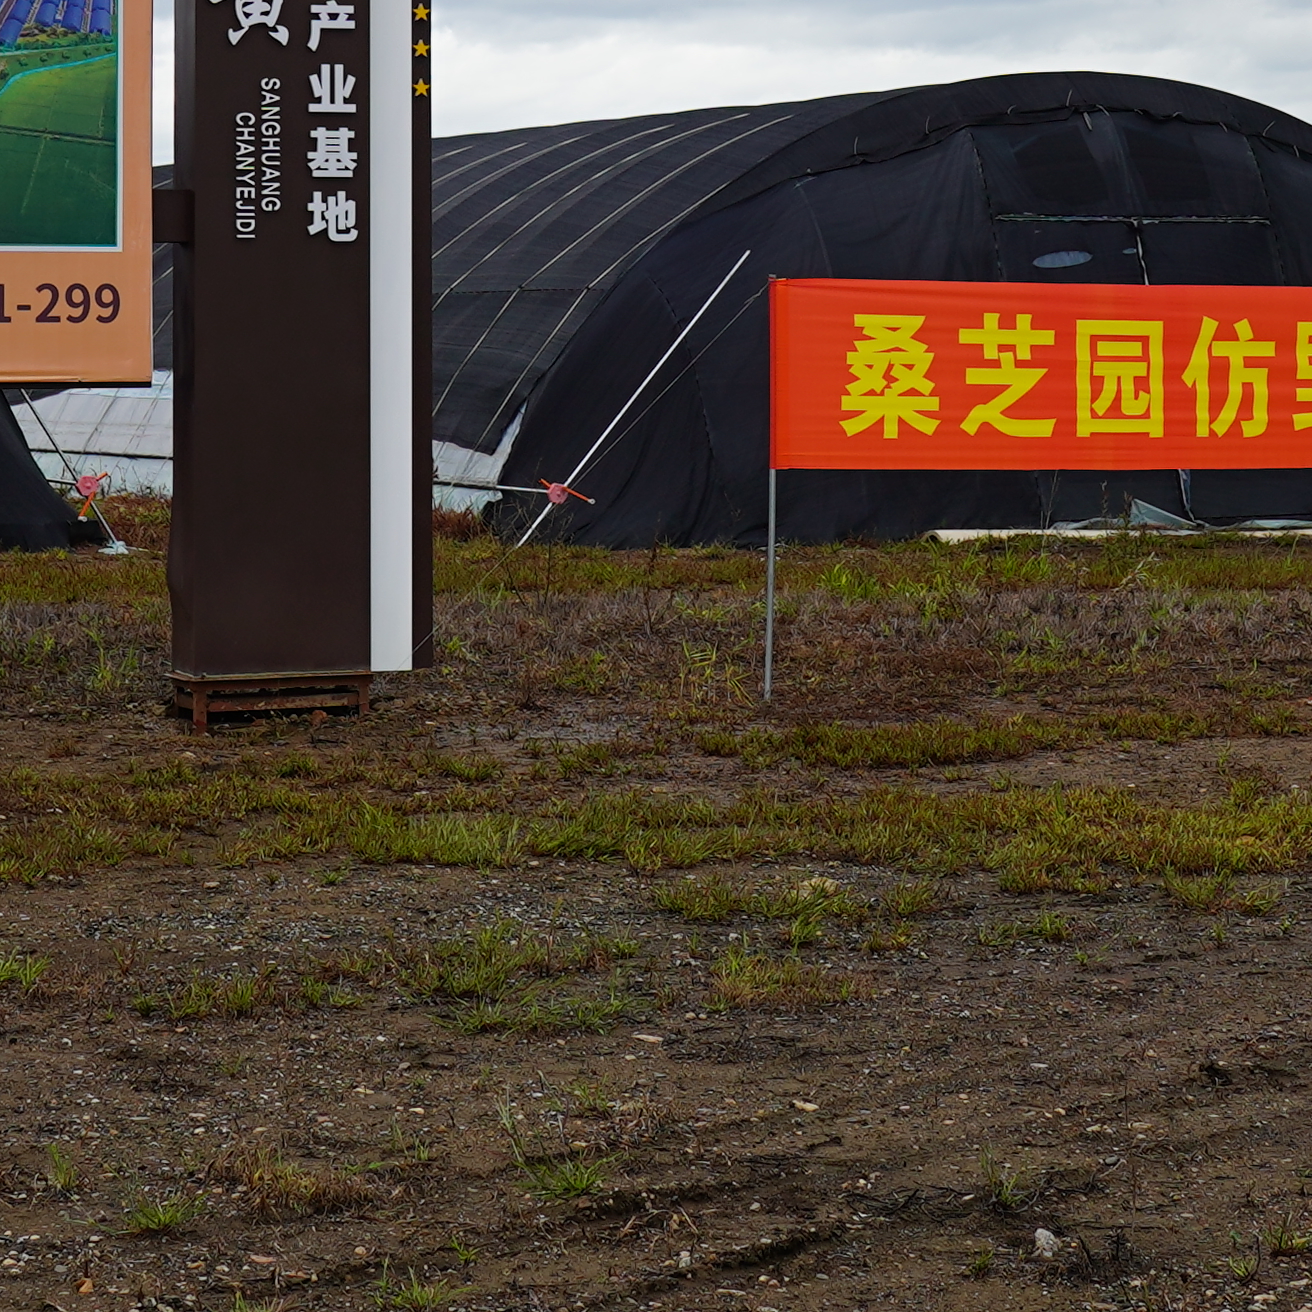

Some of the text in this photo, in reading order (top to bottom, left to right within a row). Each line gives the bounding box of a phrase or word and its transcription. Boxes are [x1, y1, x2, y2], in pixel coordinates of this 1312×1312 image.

[235, 112, 256, 239] CHANYEJIDI
[261, 77, 281, 212] SANGHUANG
[307, 0, 359, 242] 产业基地
